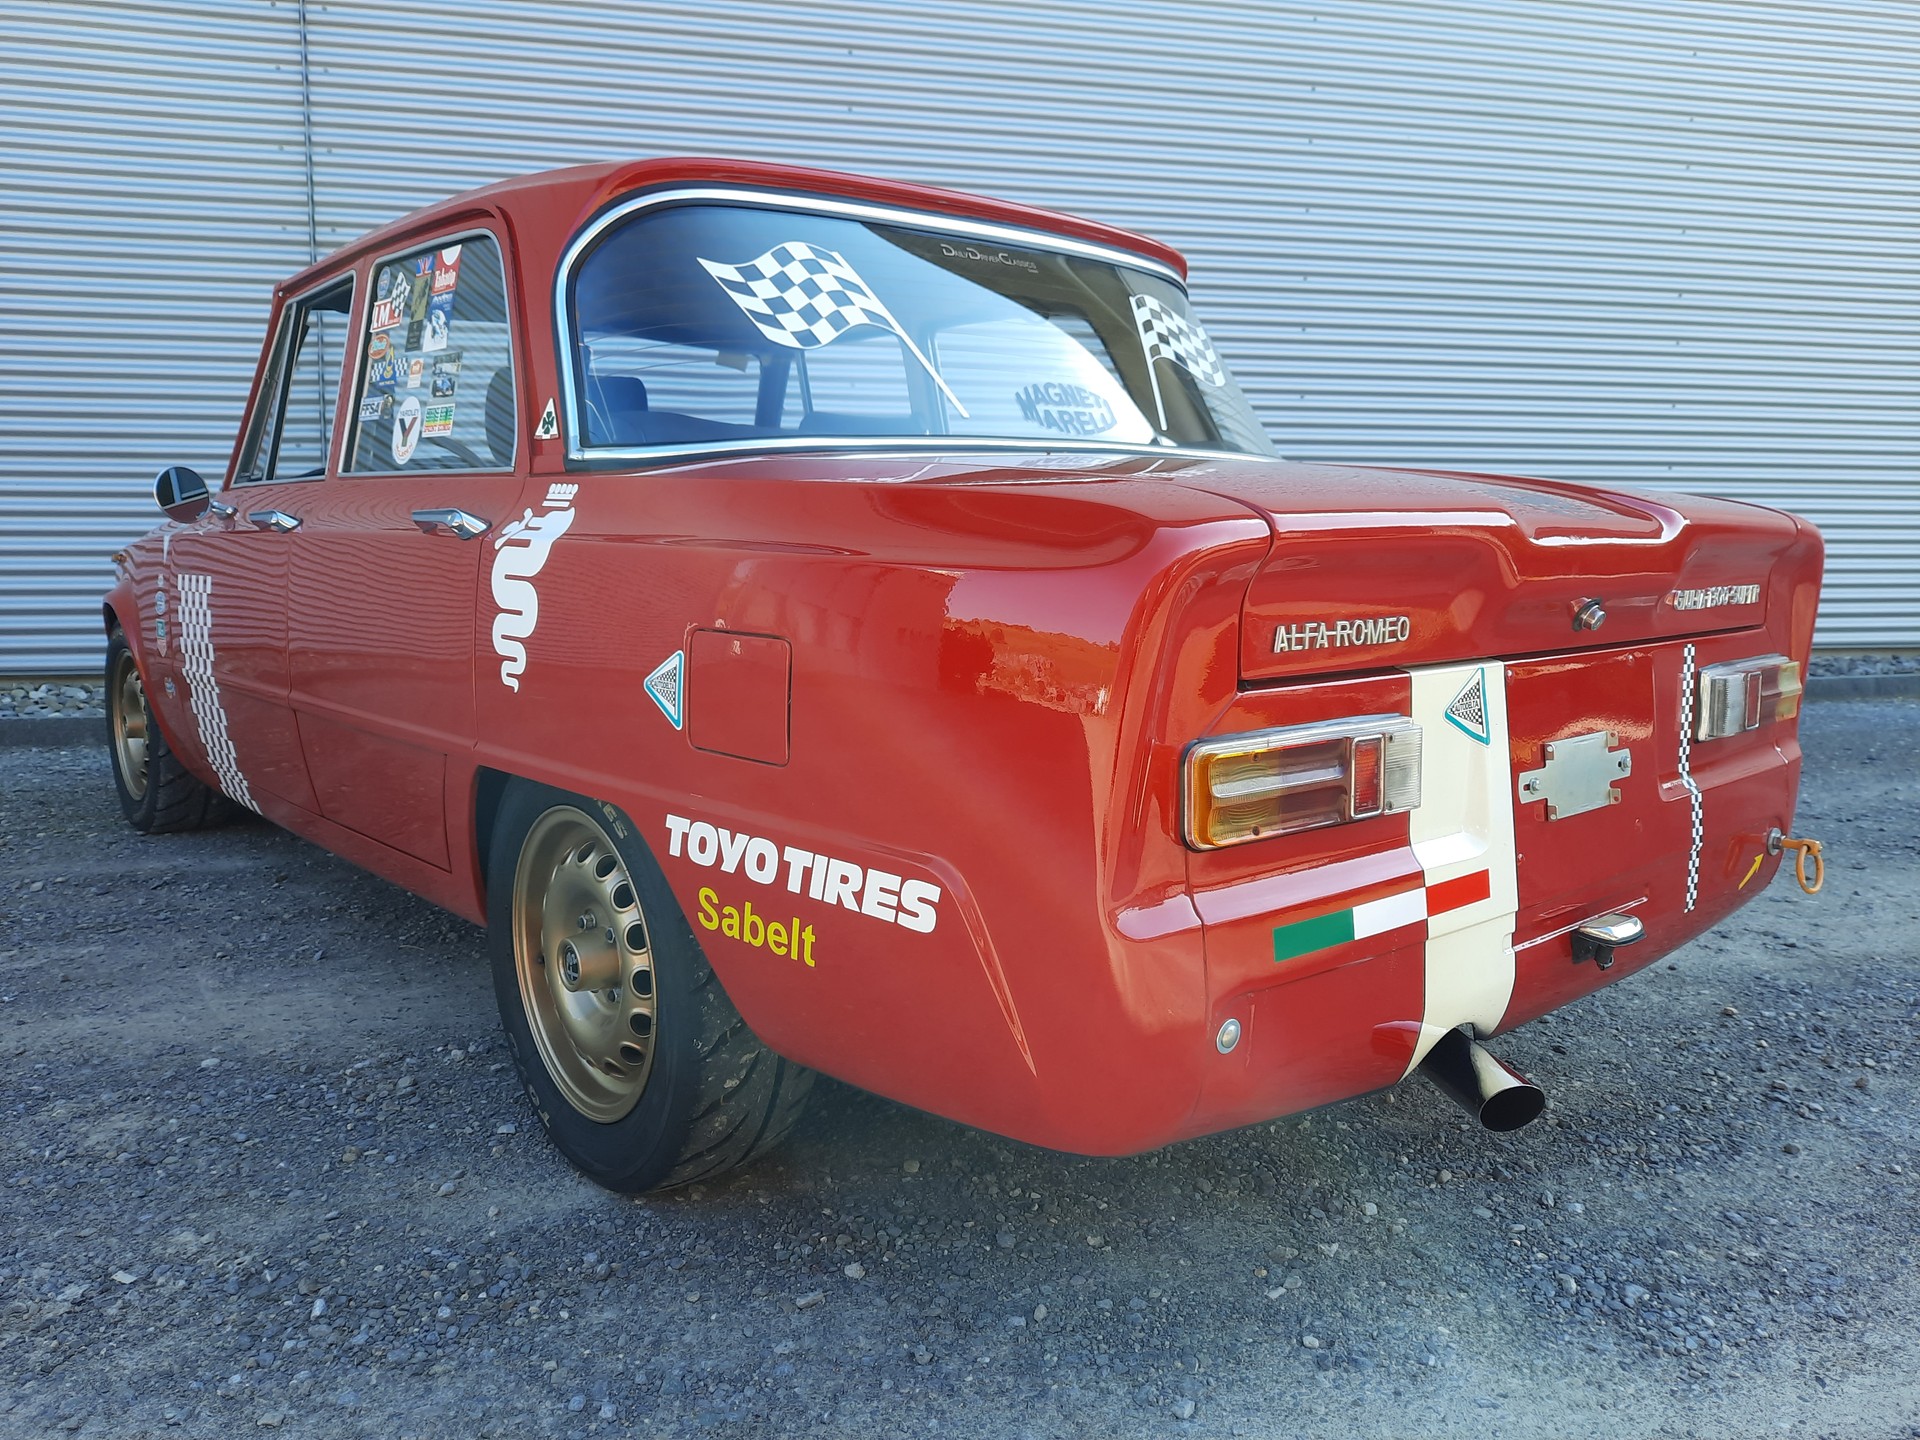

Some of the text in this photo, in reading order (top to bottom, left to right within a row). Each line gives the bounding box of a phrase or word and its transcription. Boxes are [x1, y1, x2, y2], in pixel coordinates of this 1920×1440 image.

[1454, 699, 1480, 713] AUTODELTA
[665, 813, 942, 934] TOYO TIRES
[697, 886, 816, 967] Sabelt
